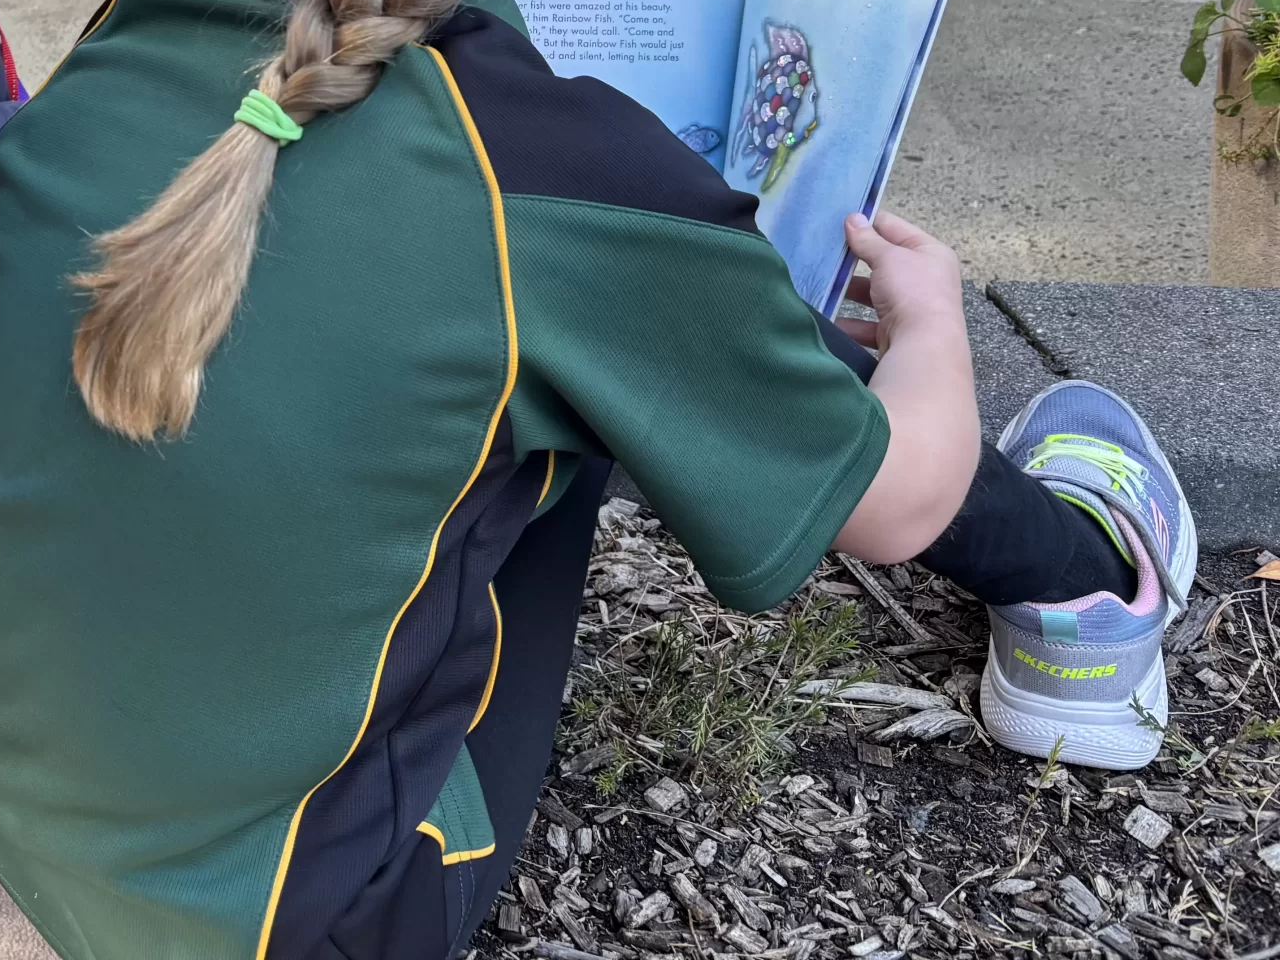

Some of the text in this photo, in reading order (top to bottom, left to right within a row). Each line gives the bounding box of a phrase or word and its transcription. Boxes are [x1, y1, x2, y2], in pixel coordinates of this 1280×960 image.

[530, 0, 546, 10] fish
[574, 1, 611, 11] amazed
[613, 3, 623, 11] at
[625, 1, 638, 11] his
[641, 1, 673, 14] beauty.
[532, 12, 549, 22] him
[552, 13, 592, 23] Rainbow
[594, 13, 615, 23] Fish.
[652, 17, 667, 25] on,
[549, 25, 568, 37] they
[571, 25, 598, 35] would
[601, 26, 620, 36] call.
[657, 27, 674, 36] and
[543, 38, 558, 47] But
[560, 38, 574, 48] the
[577, 39, 617, 48] Rainbow
[620, 39, 637, 48] Fish
[640, 40, 667, 49] would
[669, 41, 684, 51] just
[558, 50, 576, 60] and
[579, 51, 605, 62] silent,
[608, 51, 635, 63] letting
[637, 52, 650, 61] his
[653, 52, 680, 62] scales
[1013, 648, 1118, 680] SKECHERS
